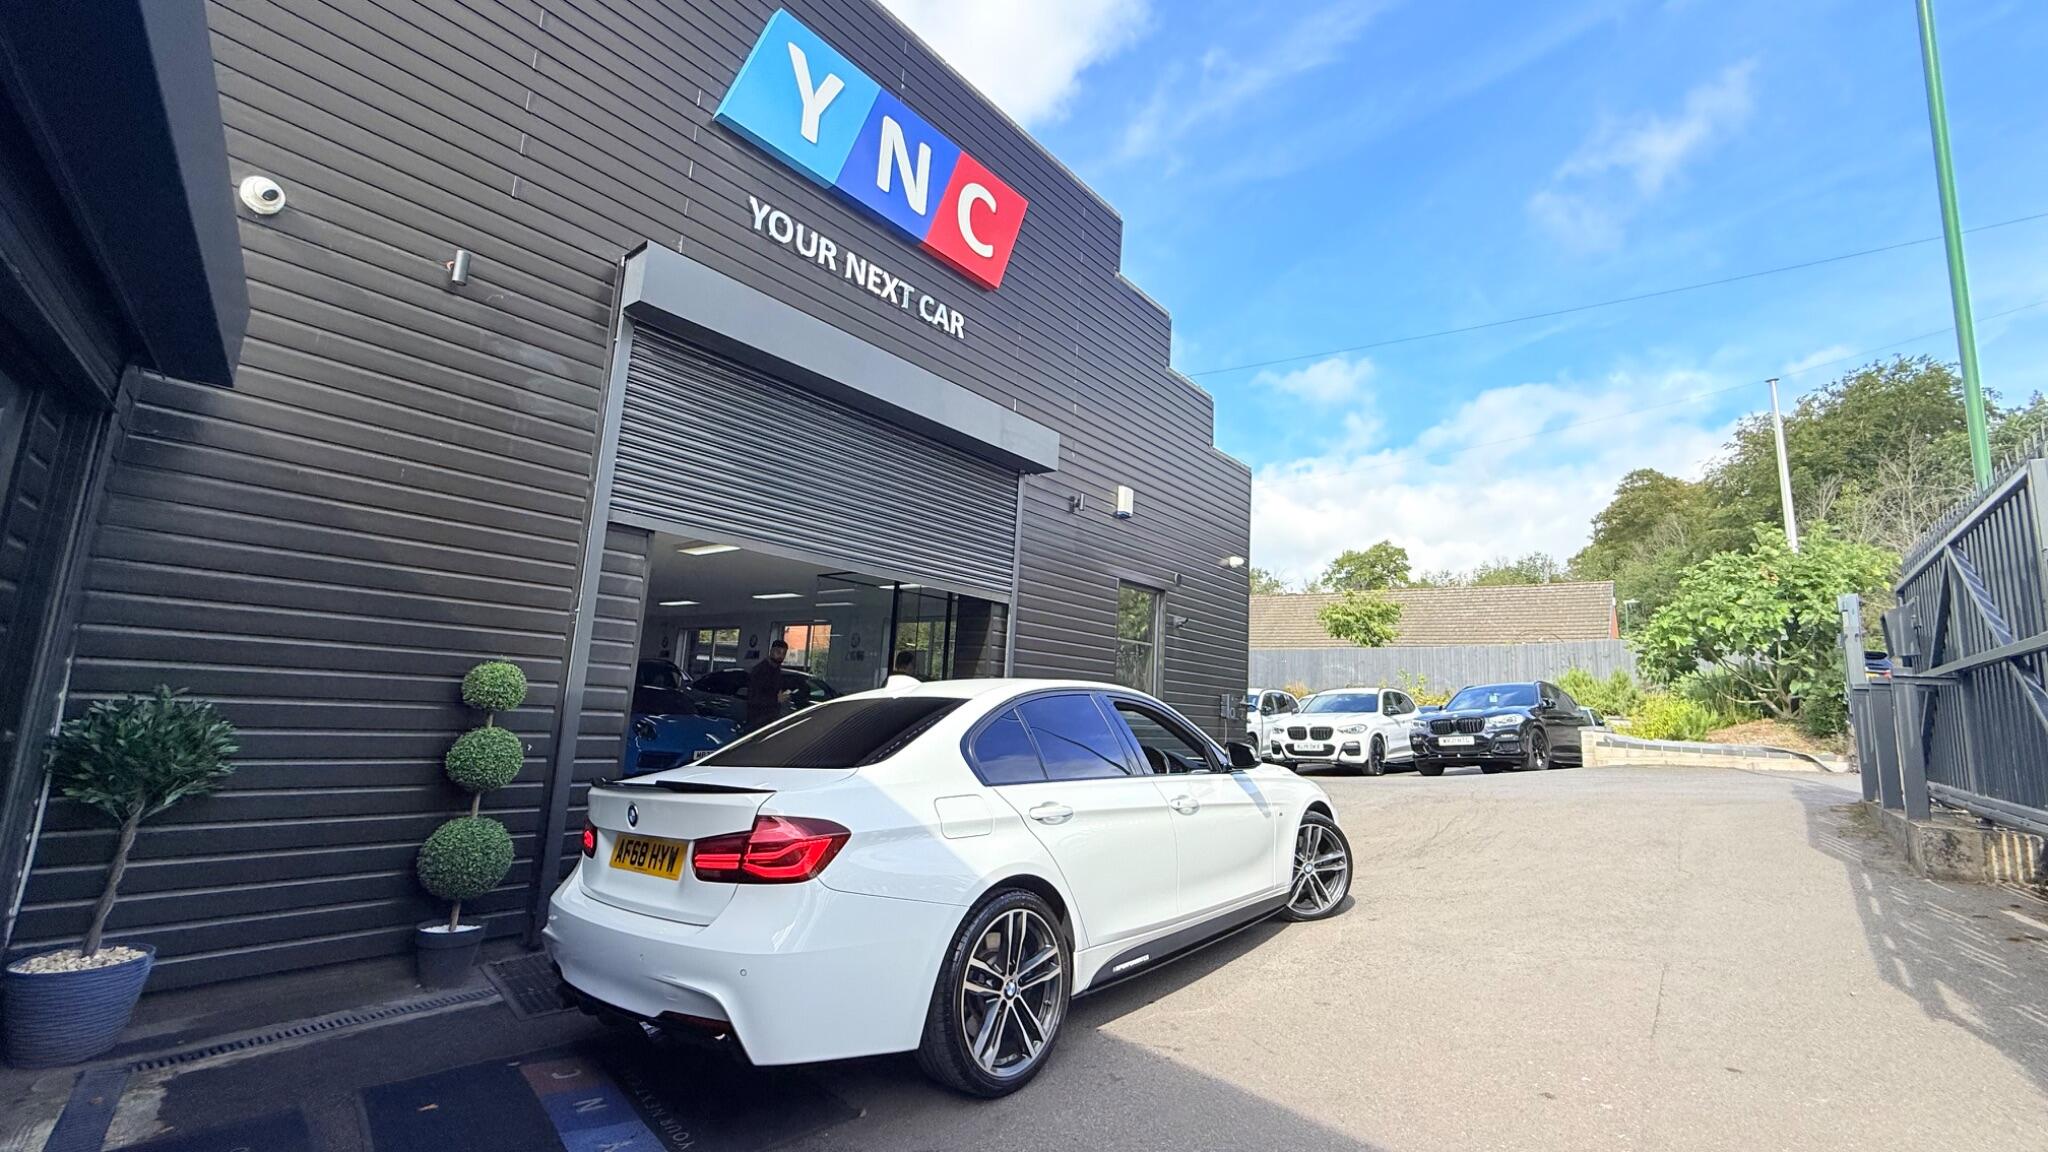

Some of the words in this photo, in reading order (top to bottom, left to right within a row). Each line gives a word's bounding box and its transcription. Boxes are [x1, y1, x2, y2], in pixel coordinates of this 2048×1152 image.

[788, 41, 997, 258] YNC
[749, 195, 838, 272] YOUR
[844, 250, 915, 309] NEXT
[918, 293, 966, 340] CAR
[614, 838, 649, 867] AF68
[648, 843, 680, 873] HYW
[658, 1116, 696, 1150] YOUR
